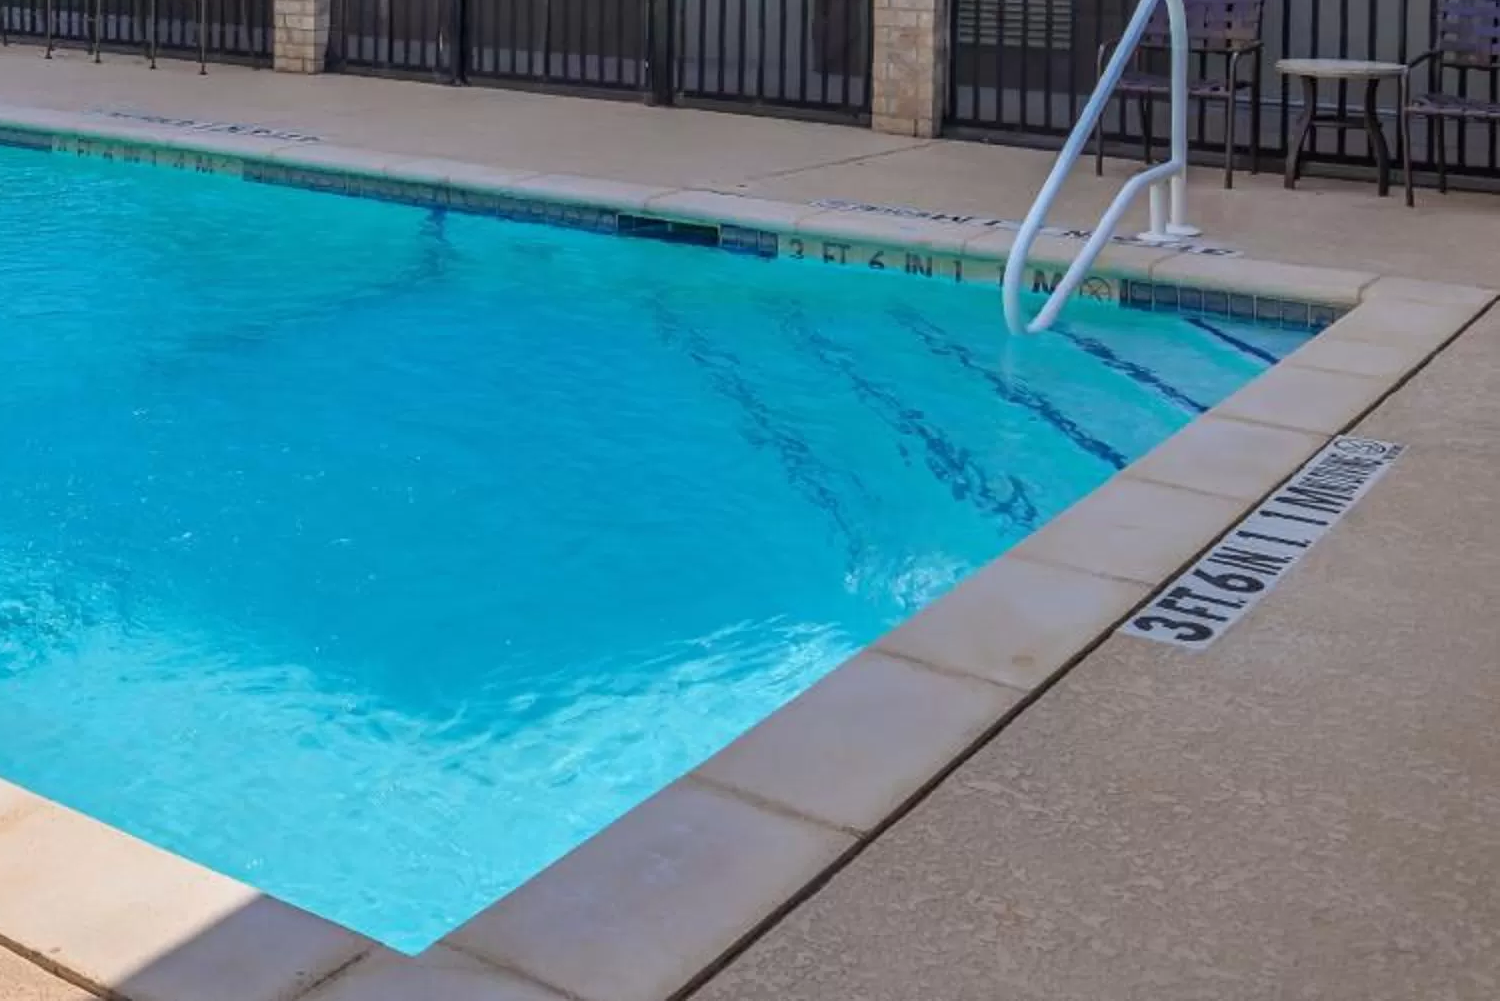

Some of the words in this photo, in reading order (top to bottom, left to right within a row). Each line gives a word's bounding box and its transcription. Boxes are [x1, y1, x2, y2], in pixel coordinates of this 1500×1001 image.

[868, 250, 885, 270] 6
[1133, 616, 1214, 642] 3
[1192, 569, 1266, 594] 6
[1274, 486, 1354, 514] M
